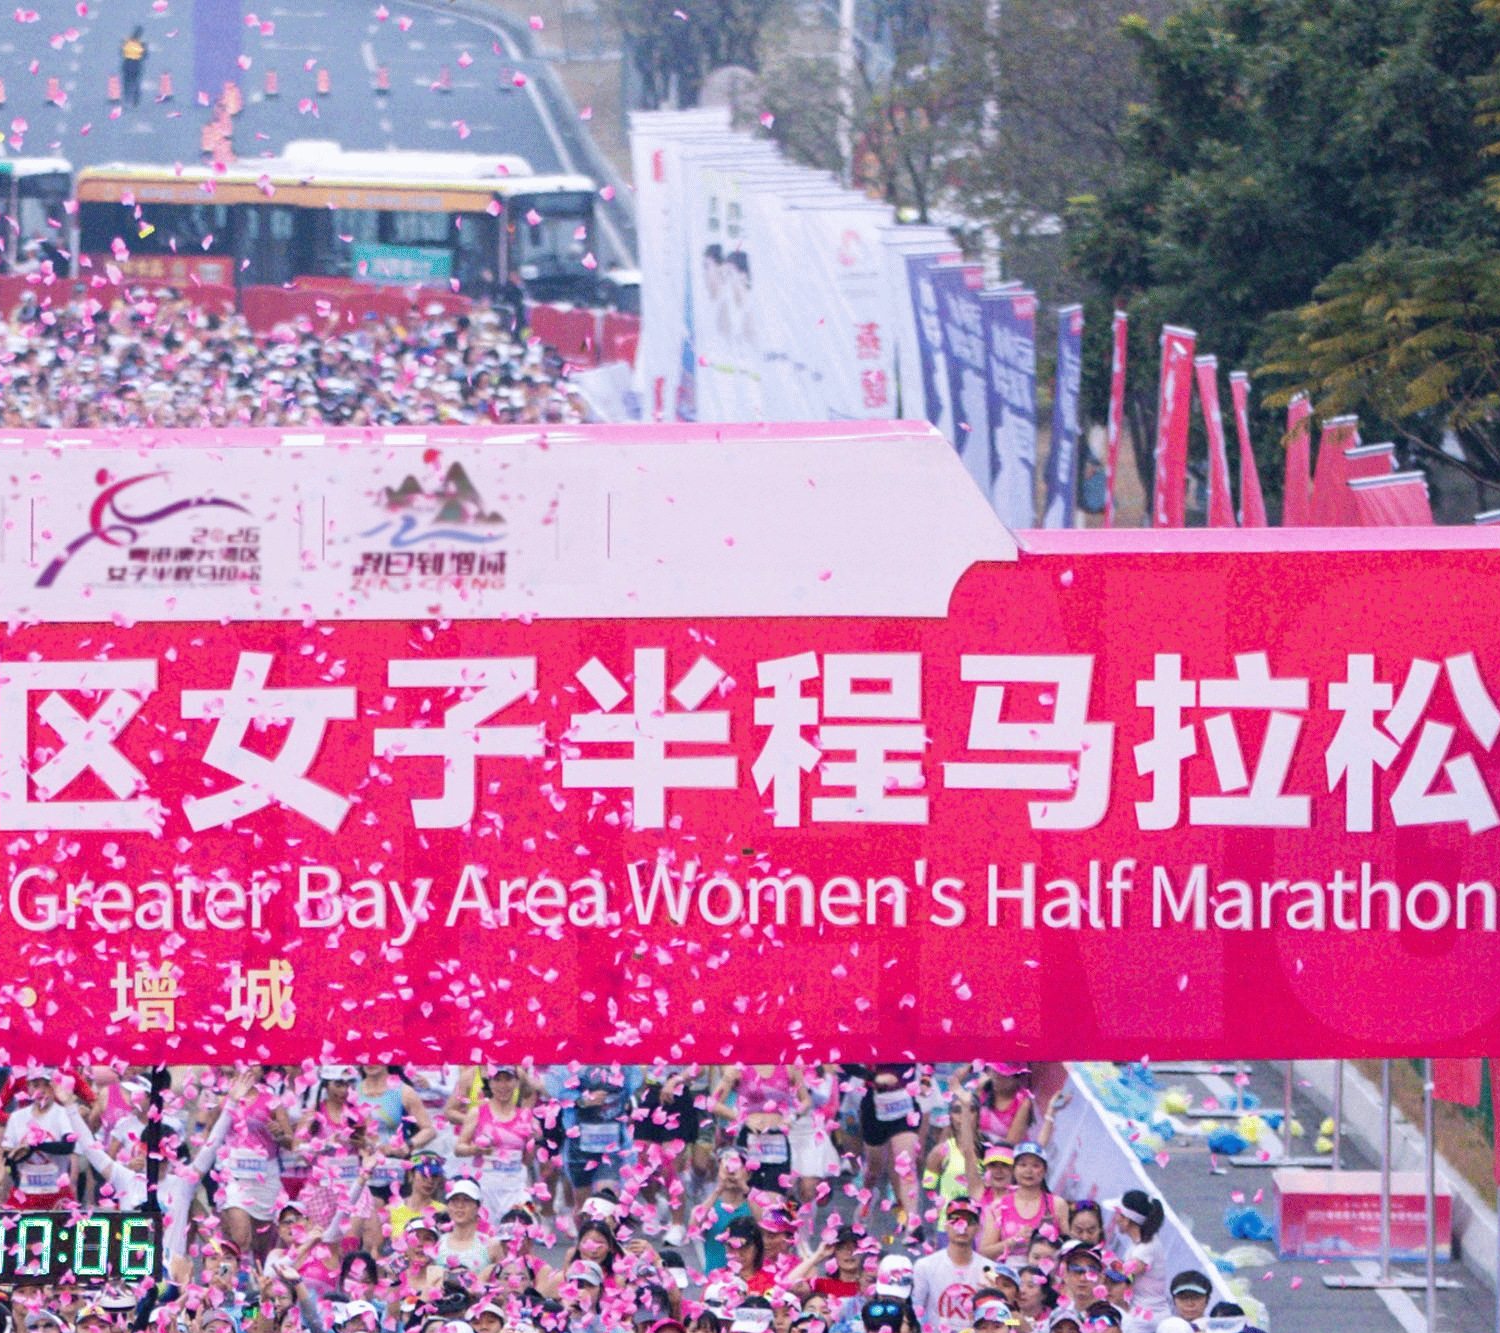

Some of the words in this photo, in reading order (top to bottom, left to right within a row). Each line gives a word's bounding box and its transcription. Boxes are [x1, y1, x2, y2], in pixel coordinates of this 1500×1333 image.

[9, 868, 266, 932] Greater
[296, 866, 435, 945] Bay
[446, 866, 607, 931] Area
[630, 864, 966, 930] Women's
[987, 859, 1134, 929] Half
[1152, 861, 1498, 930] Marathon
